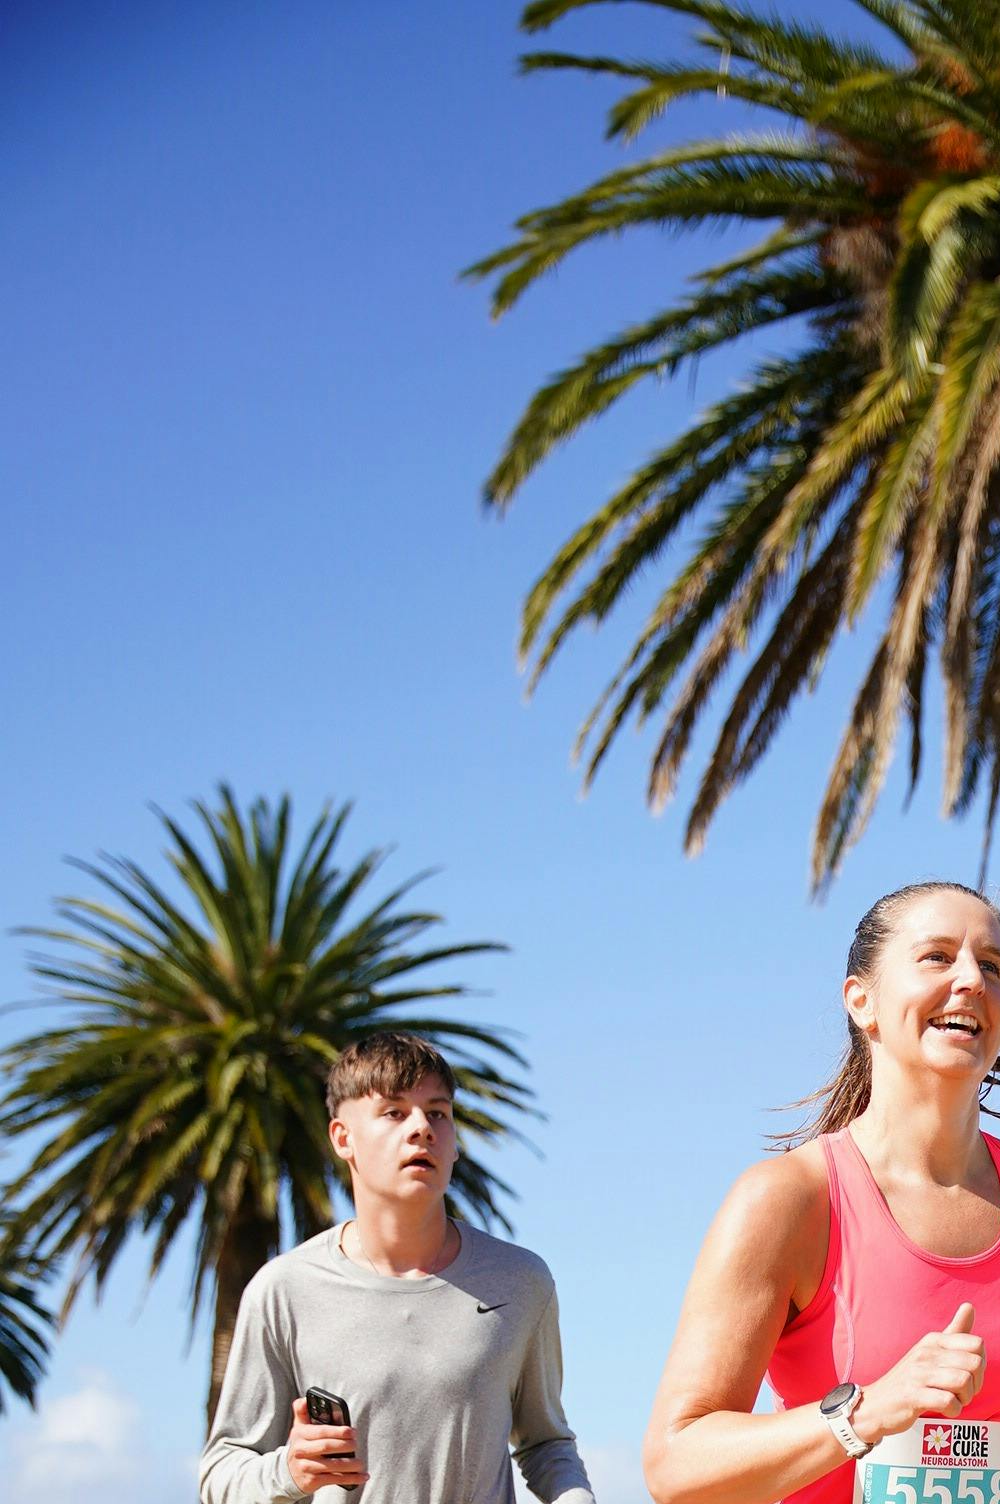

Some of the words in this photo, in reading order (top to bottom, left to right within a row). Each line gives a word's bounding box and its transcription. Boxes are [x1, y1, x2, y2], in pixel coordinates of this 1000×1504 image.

[953, 1424, 989, 1441] RUN2
[953, 1440, 988, 1458] CURE
[921, 1456, 988, 1467] NEUROBLASTOMA
